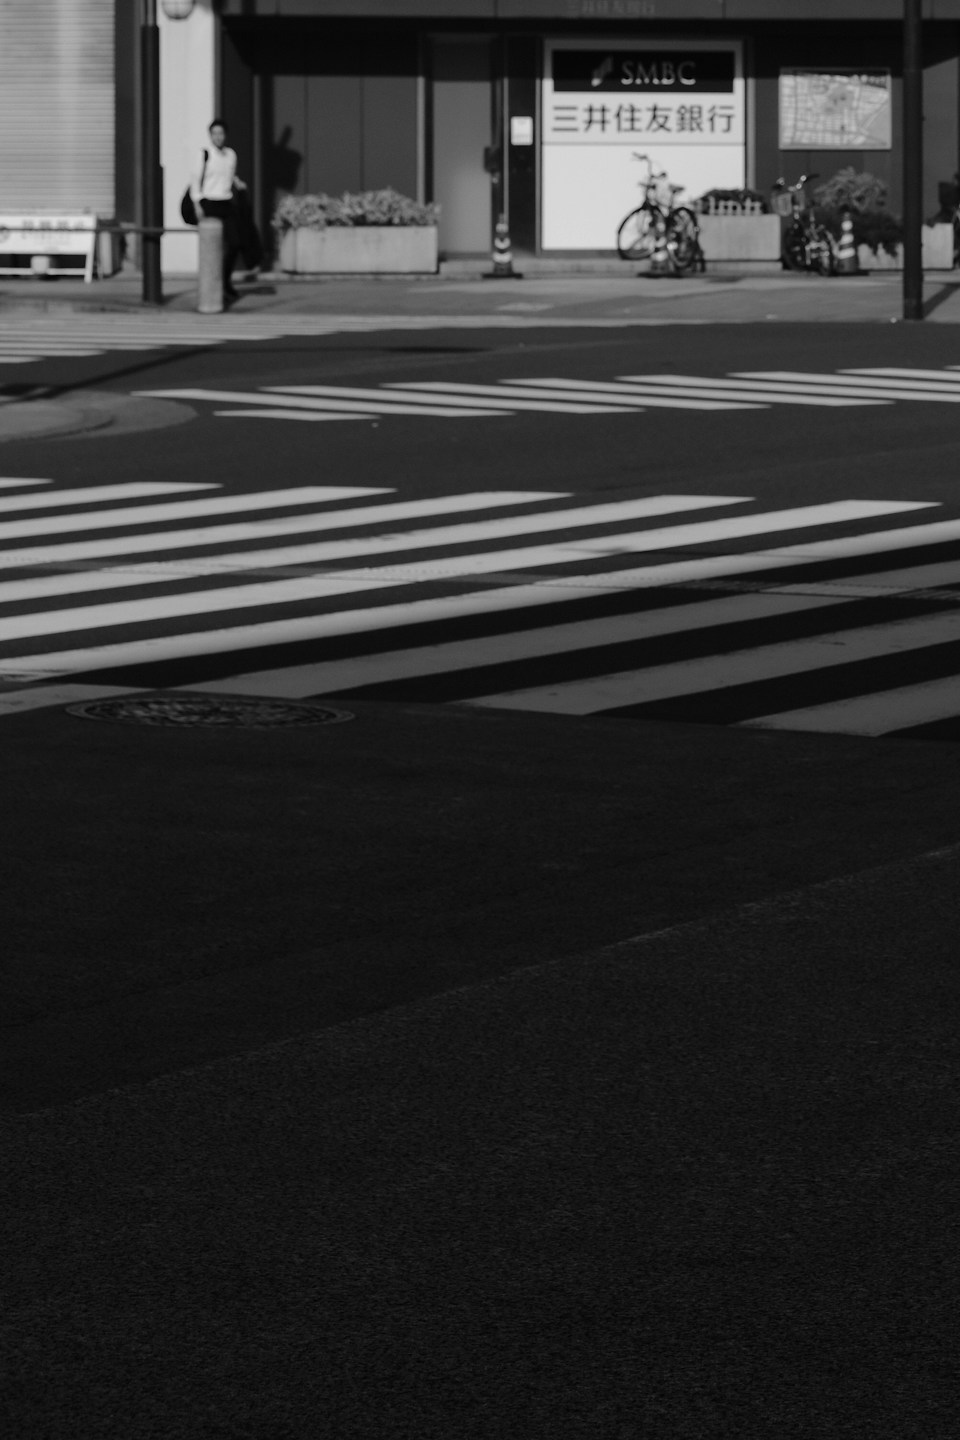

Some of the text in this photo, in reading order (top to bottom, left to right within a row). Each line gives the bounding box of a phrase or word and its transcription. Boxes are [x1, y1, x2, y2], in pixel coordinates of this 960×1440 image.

[621, 61, 696, 85] SMBC
[552, 104, 736, 134] 三井住友銀行
